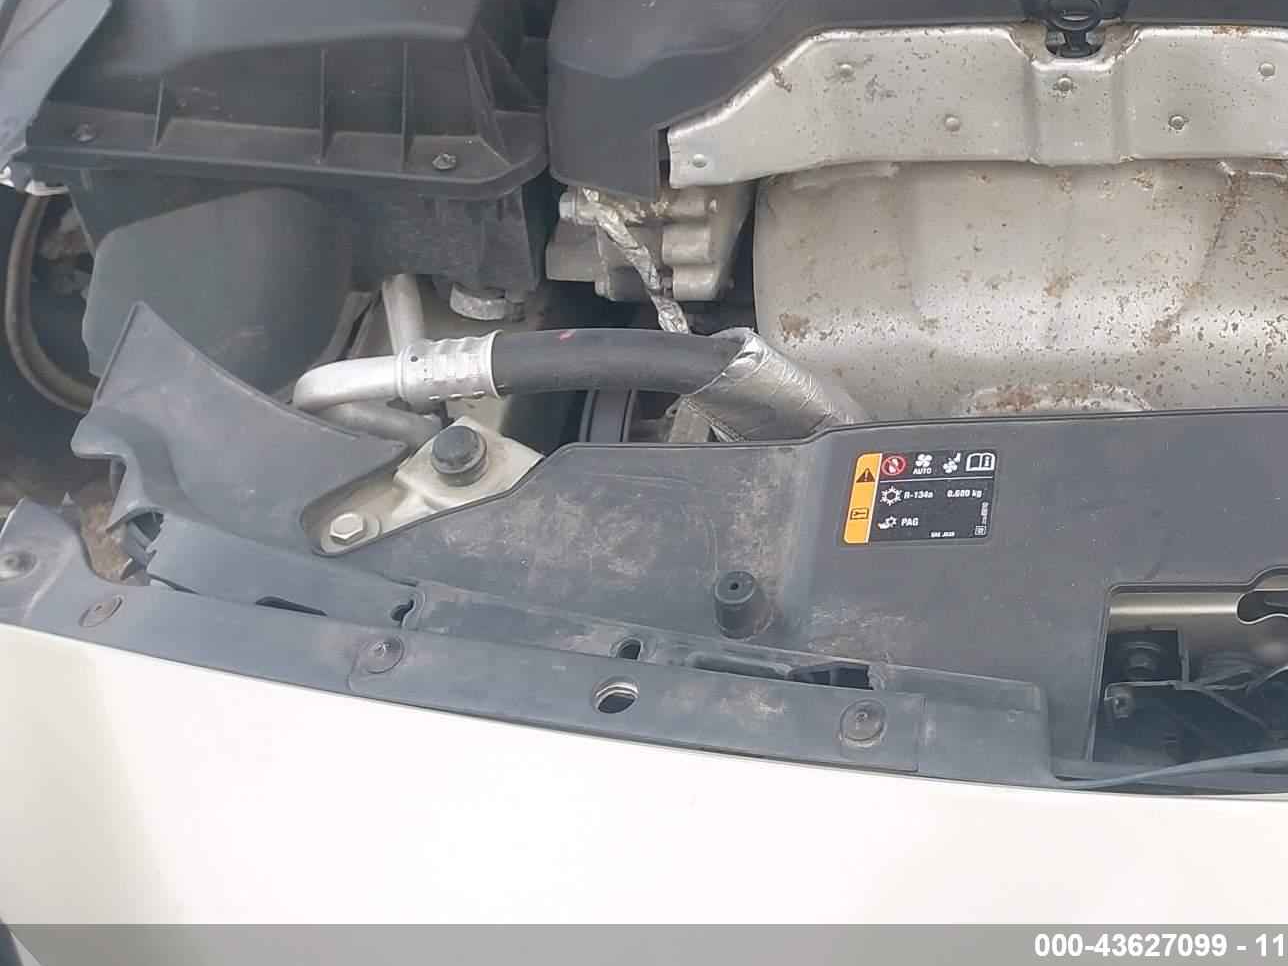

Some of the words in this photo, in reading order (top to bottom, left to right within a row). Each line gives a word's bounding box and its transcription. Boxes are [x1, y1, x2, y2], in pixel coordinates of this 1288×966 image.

[913, 467, 932, 475] AUTO
[904, 490, 933, 499] R-134a
[972, 489, 982, 499] kg
[901, 517, 919, 527] PAG
